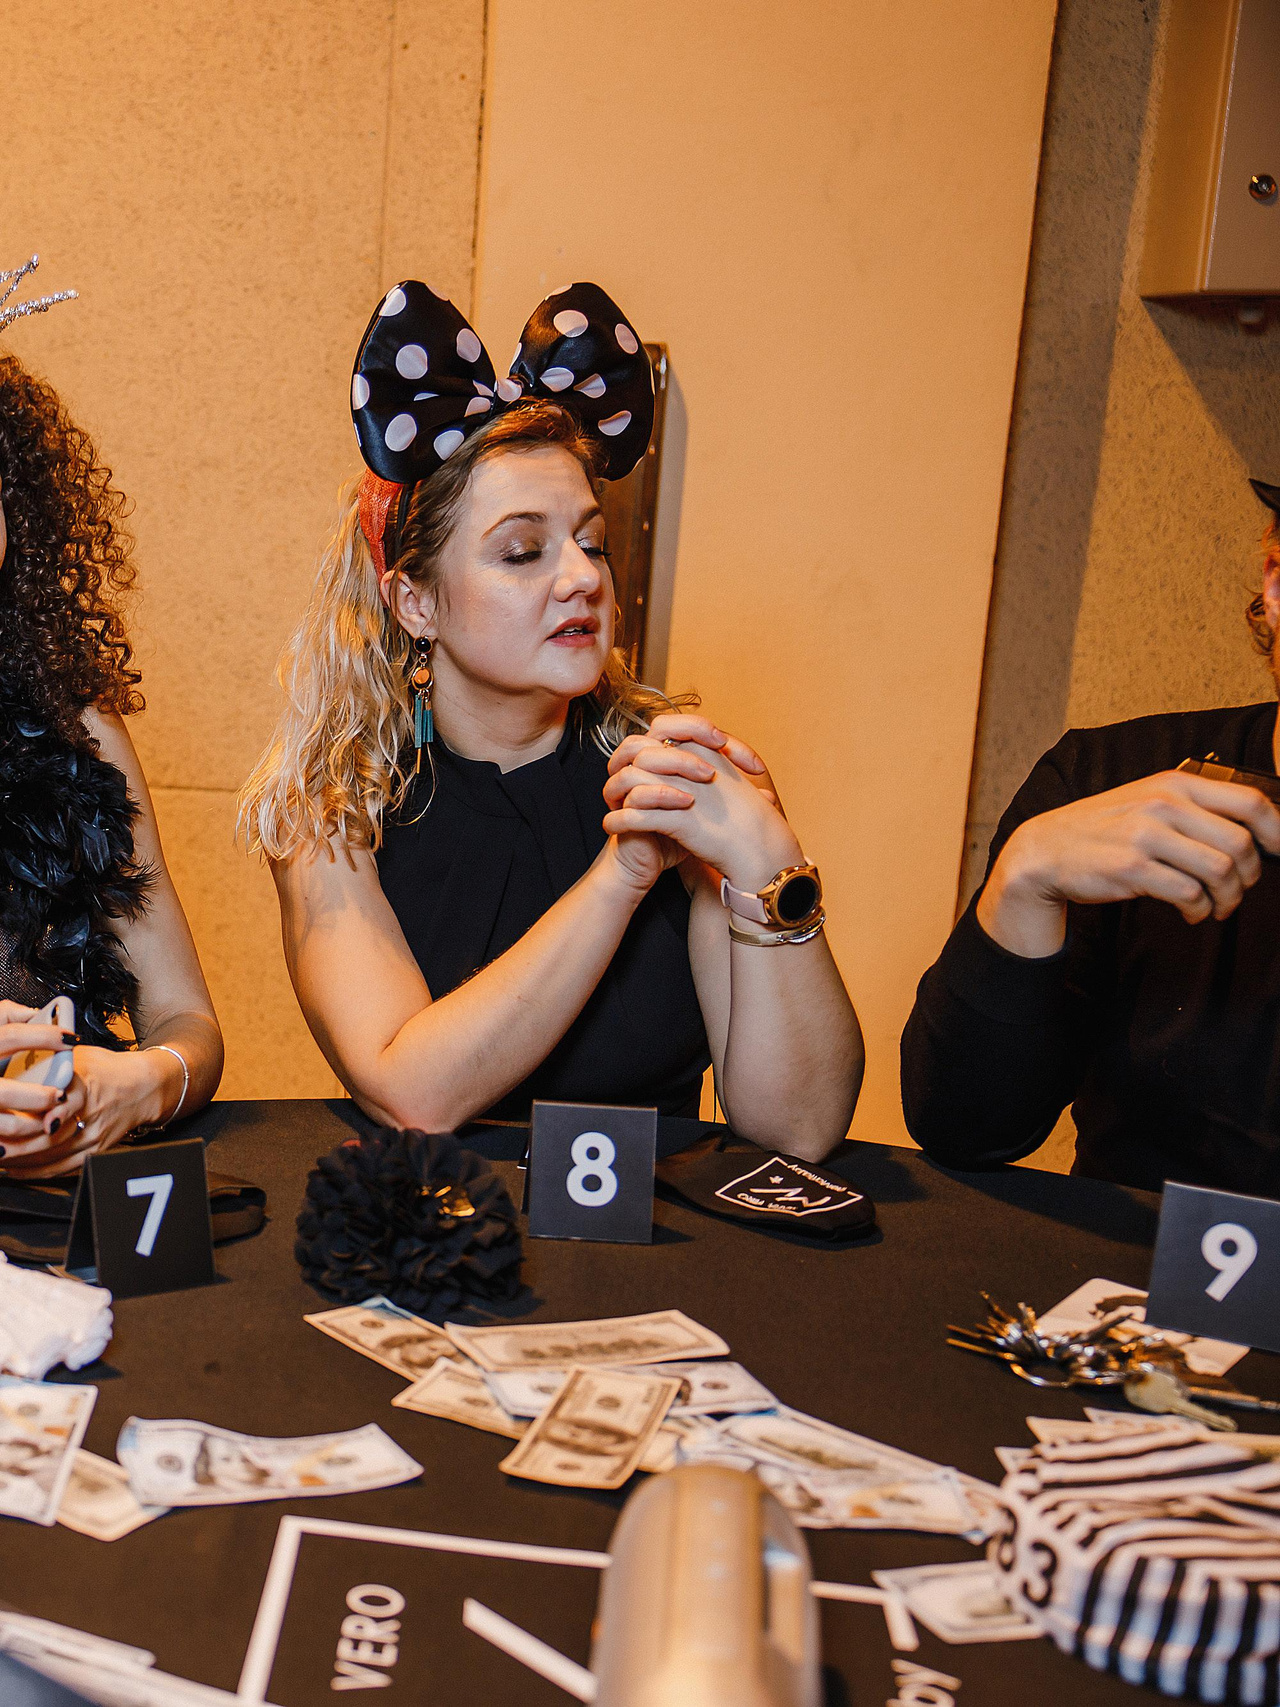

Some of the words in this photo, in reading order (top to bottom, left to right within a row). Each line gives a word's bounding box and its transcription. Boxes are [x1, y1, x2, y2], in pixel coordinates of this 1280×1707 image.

[566, 1131, 618, 1207] 8
[126, 1173, 174, 1257] 7
[1201, 1222, 1258, 1302] 9
[330, 1583, 406, 1691] VERO
